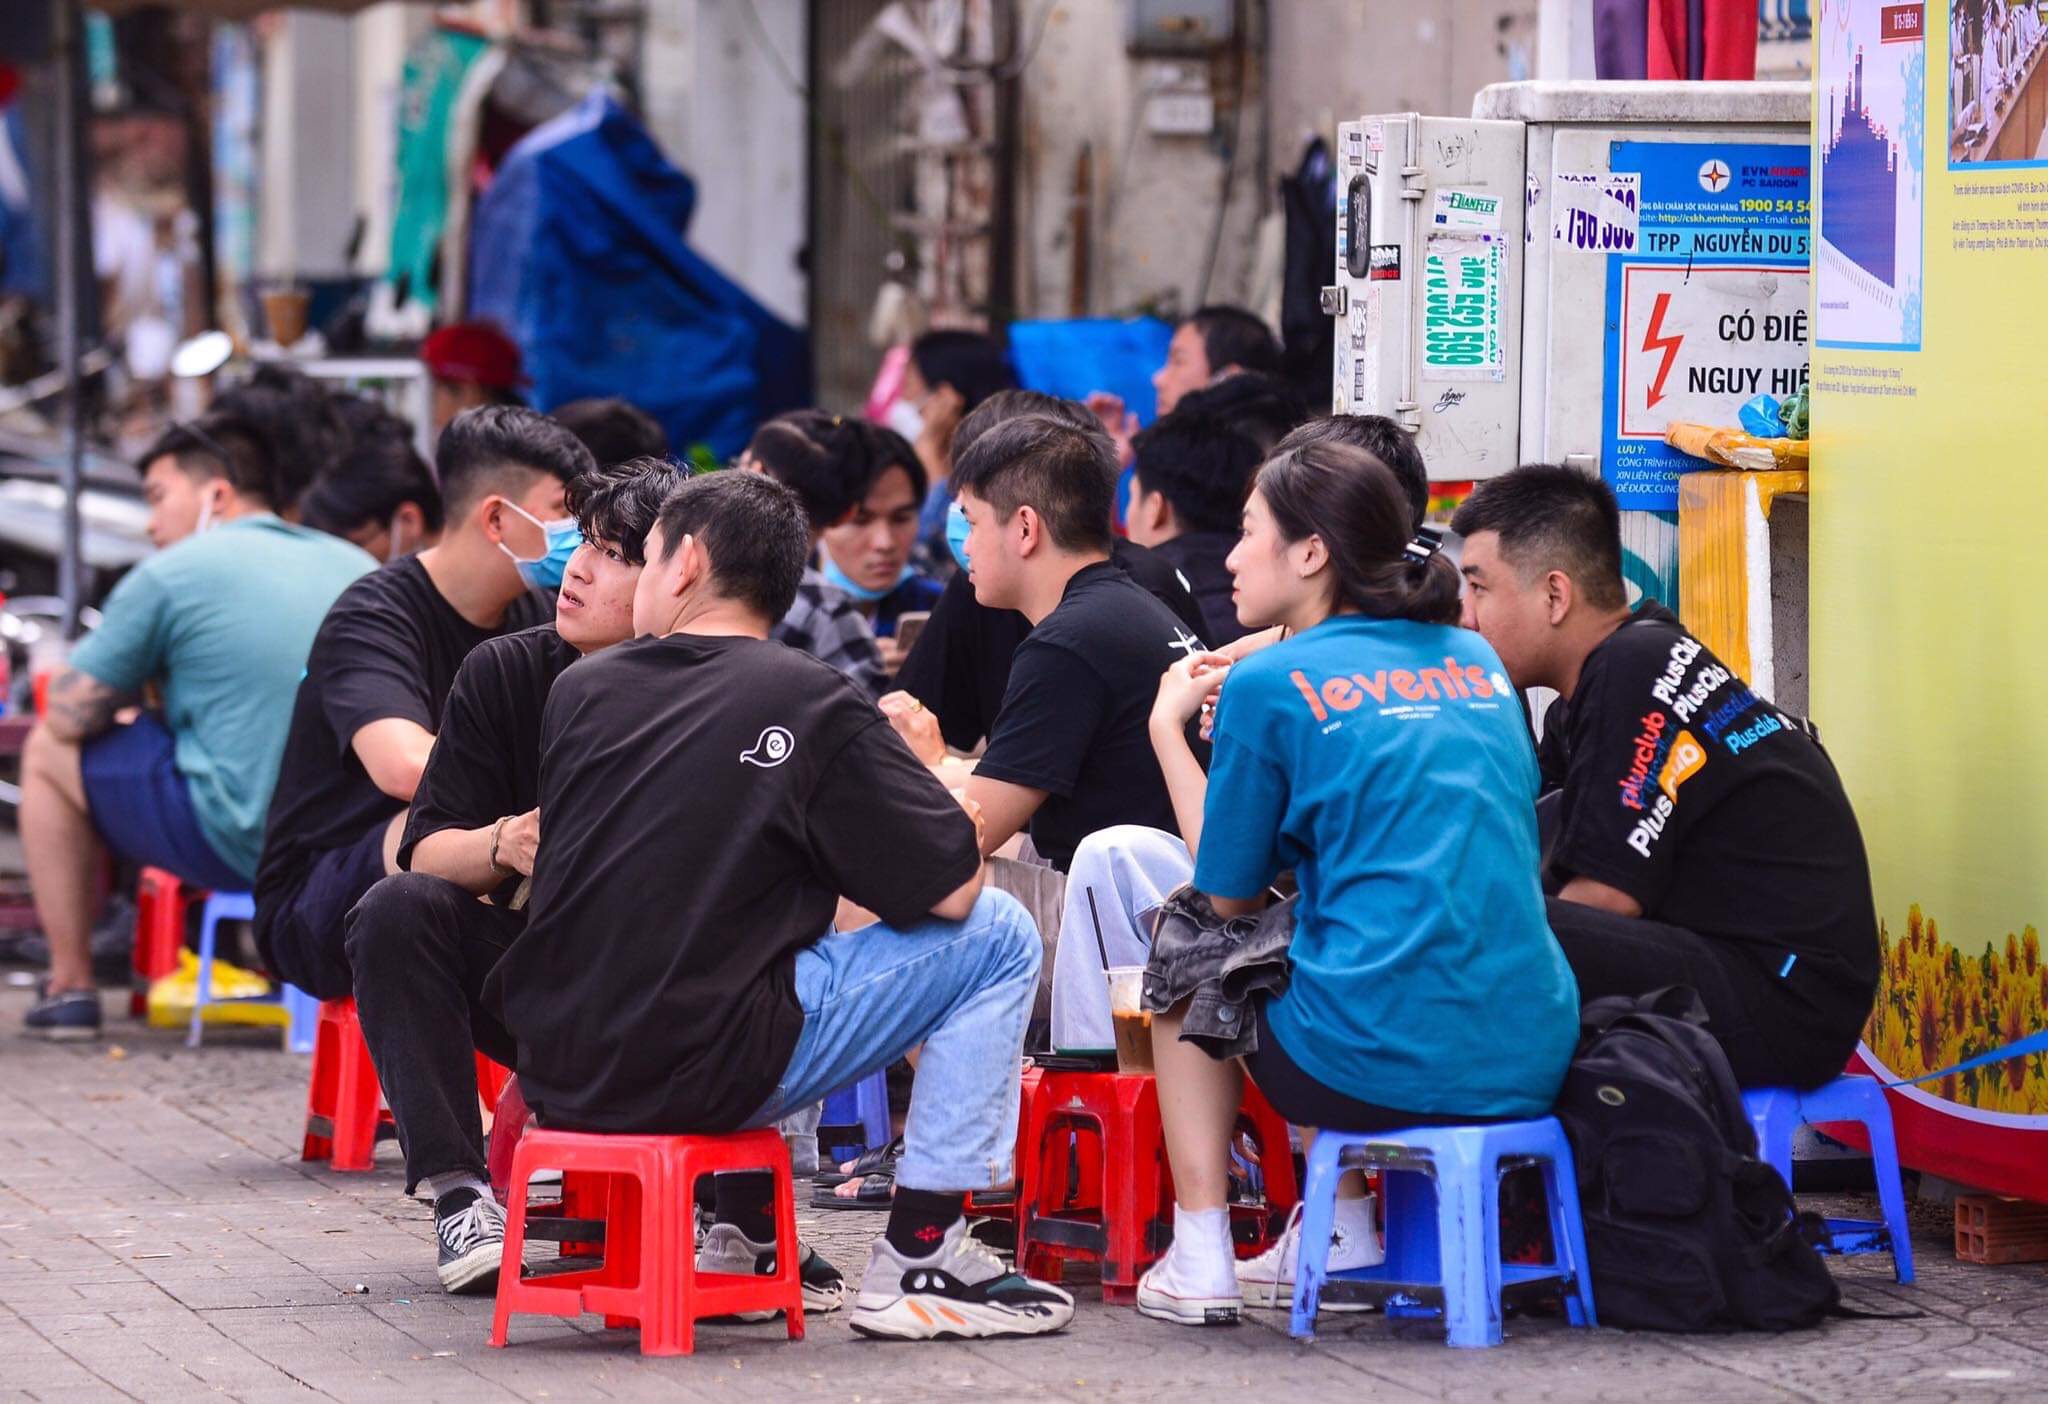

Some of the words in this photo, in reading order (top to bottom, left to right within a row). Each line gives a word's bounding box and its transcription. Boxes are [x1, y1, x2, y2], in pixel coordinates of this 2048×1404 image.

[1739, 199, 1772, 212] 1900
[1776, 200, 1793, 213] 54
[1766, 215, 1789, 224] Email:
[1768, 235, 1792, 254] DU
[1797, 236, 1811, 254] 5
[1718, 308, 1755, 342] CÓ
[1688, 366, 1762, 394] NGUY
[1616, 457, 1642, 467] CÔNG
[1643, 457, 1668, 468] TRÌNH
[1289, 656, 1494, 722] levents
[1626, 795, 1674, 859] Plus
